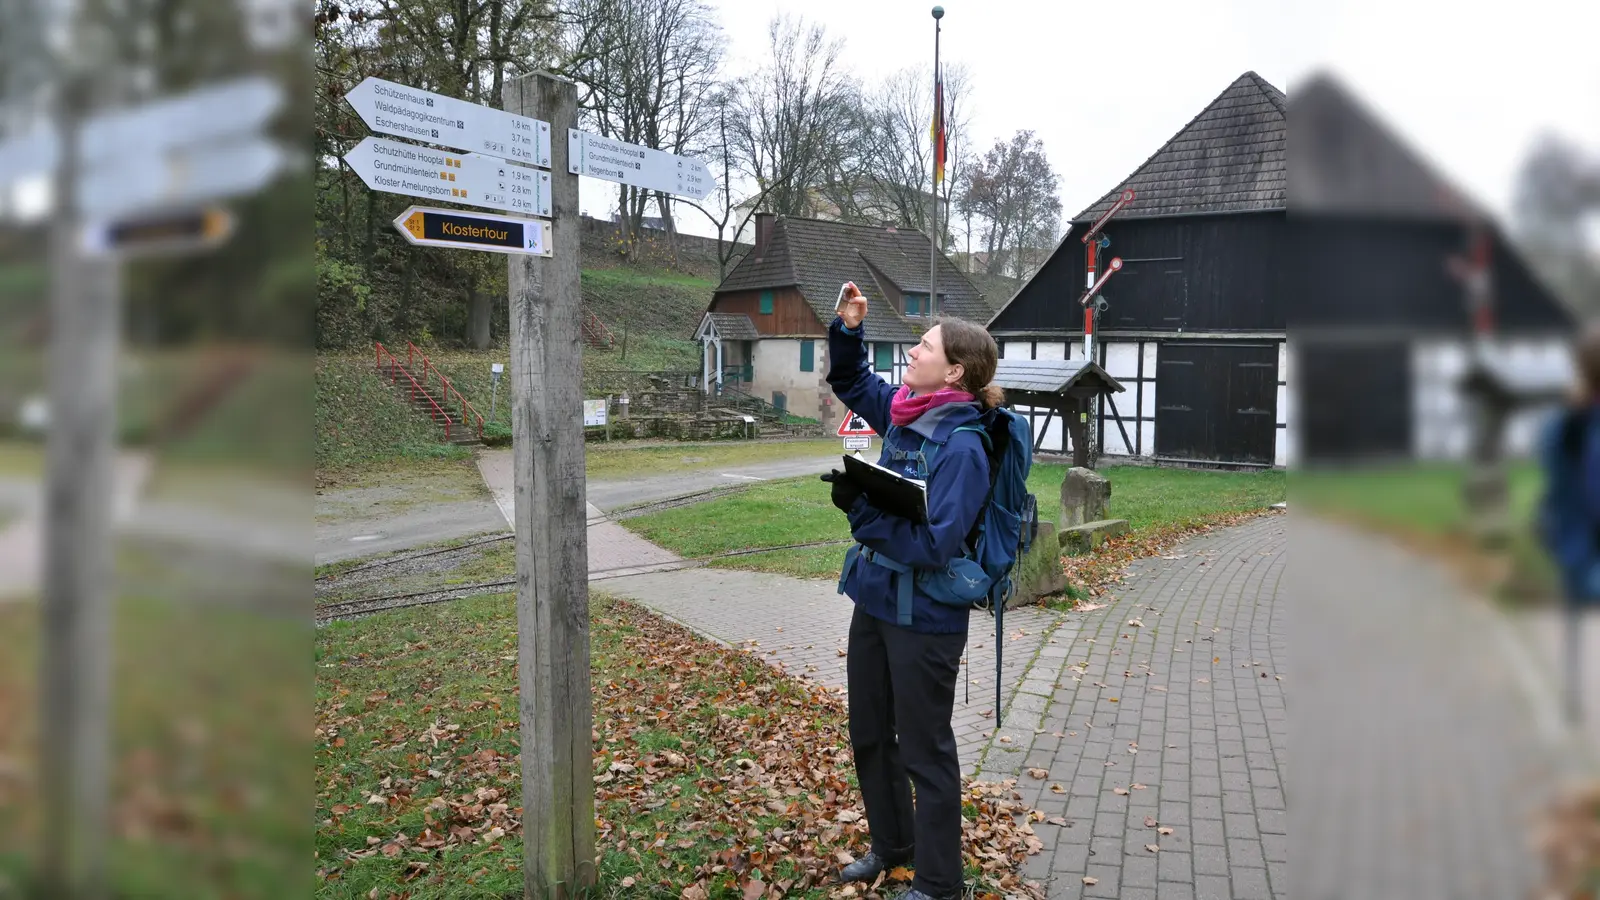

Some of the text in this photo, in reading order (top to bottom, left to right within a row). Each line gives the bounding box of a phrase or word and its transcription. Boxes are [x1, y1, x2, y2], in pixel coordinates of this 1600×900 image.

[374, 84, 425, 105] Schützenhaus
[374, 100, 456, 128] Waldpädagogikzentrum
[375, 116, 430, 136] Eschershausen
[522, 121, 531, 131] km
[511, 133, 531, 145] 3,7 km
[589, 138, 619, 153] Schutzhütte
[373, 143, 416, 160] Schutzhütte
[417, 152, 444, 166] Hooptal
[522, 148, 532, 158] km
[589, 151, 635, 169] Grundmühlenteich
[373, 159, 439, 179] Grundmühlenteich
[588, 164, 618, 177] Negenborn
[690, 163, 694, 171] 2
[511, 170, 531, 181] 1,9 km
[374, 175, 401, 188] Kloster
[401, 180, 451, 196] Amelungsborn
[511, 184, 532, 195] 2,8 km
[695, 187, 701, 195] km
[511, 198, 532, 209] 2,9 km
[442, 221, 508, 241] Klostertour
